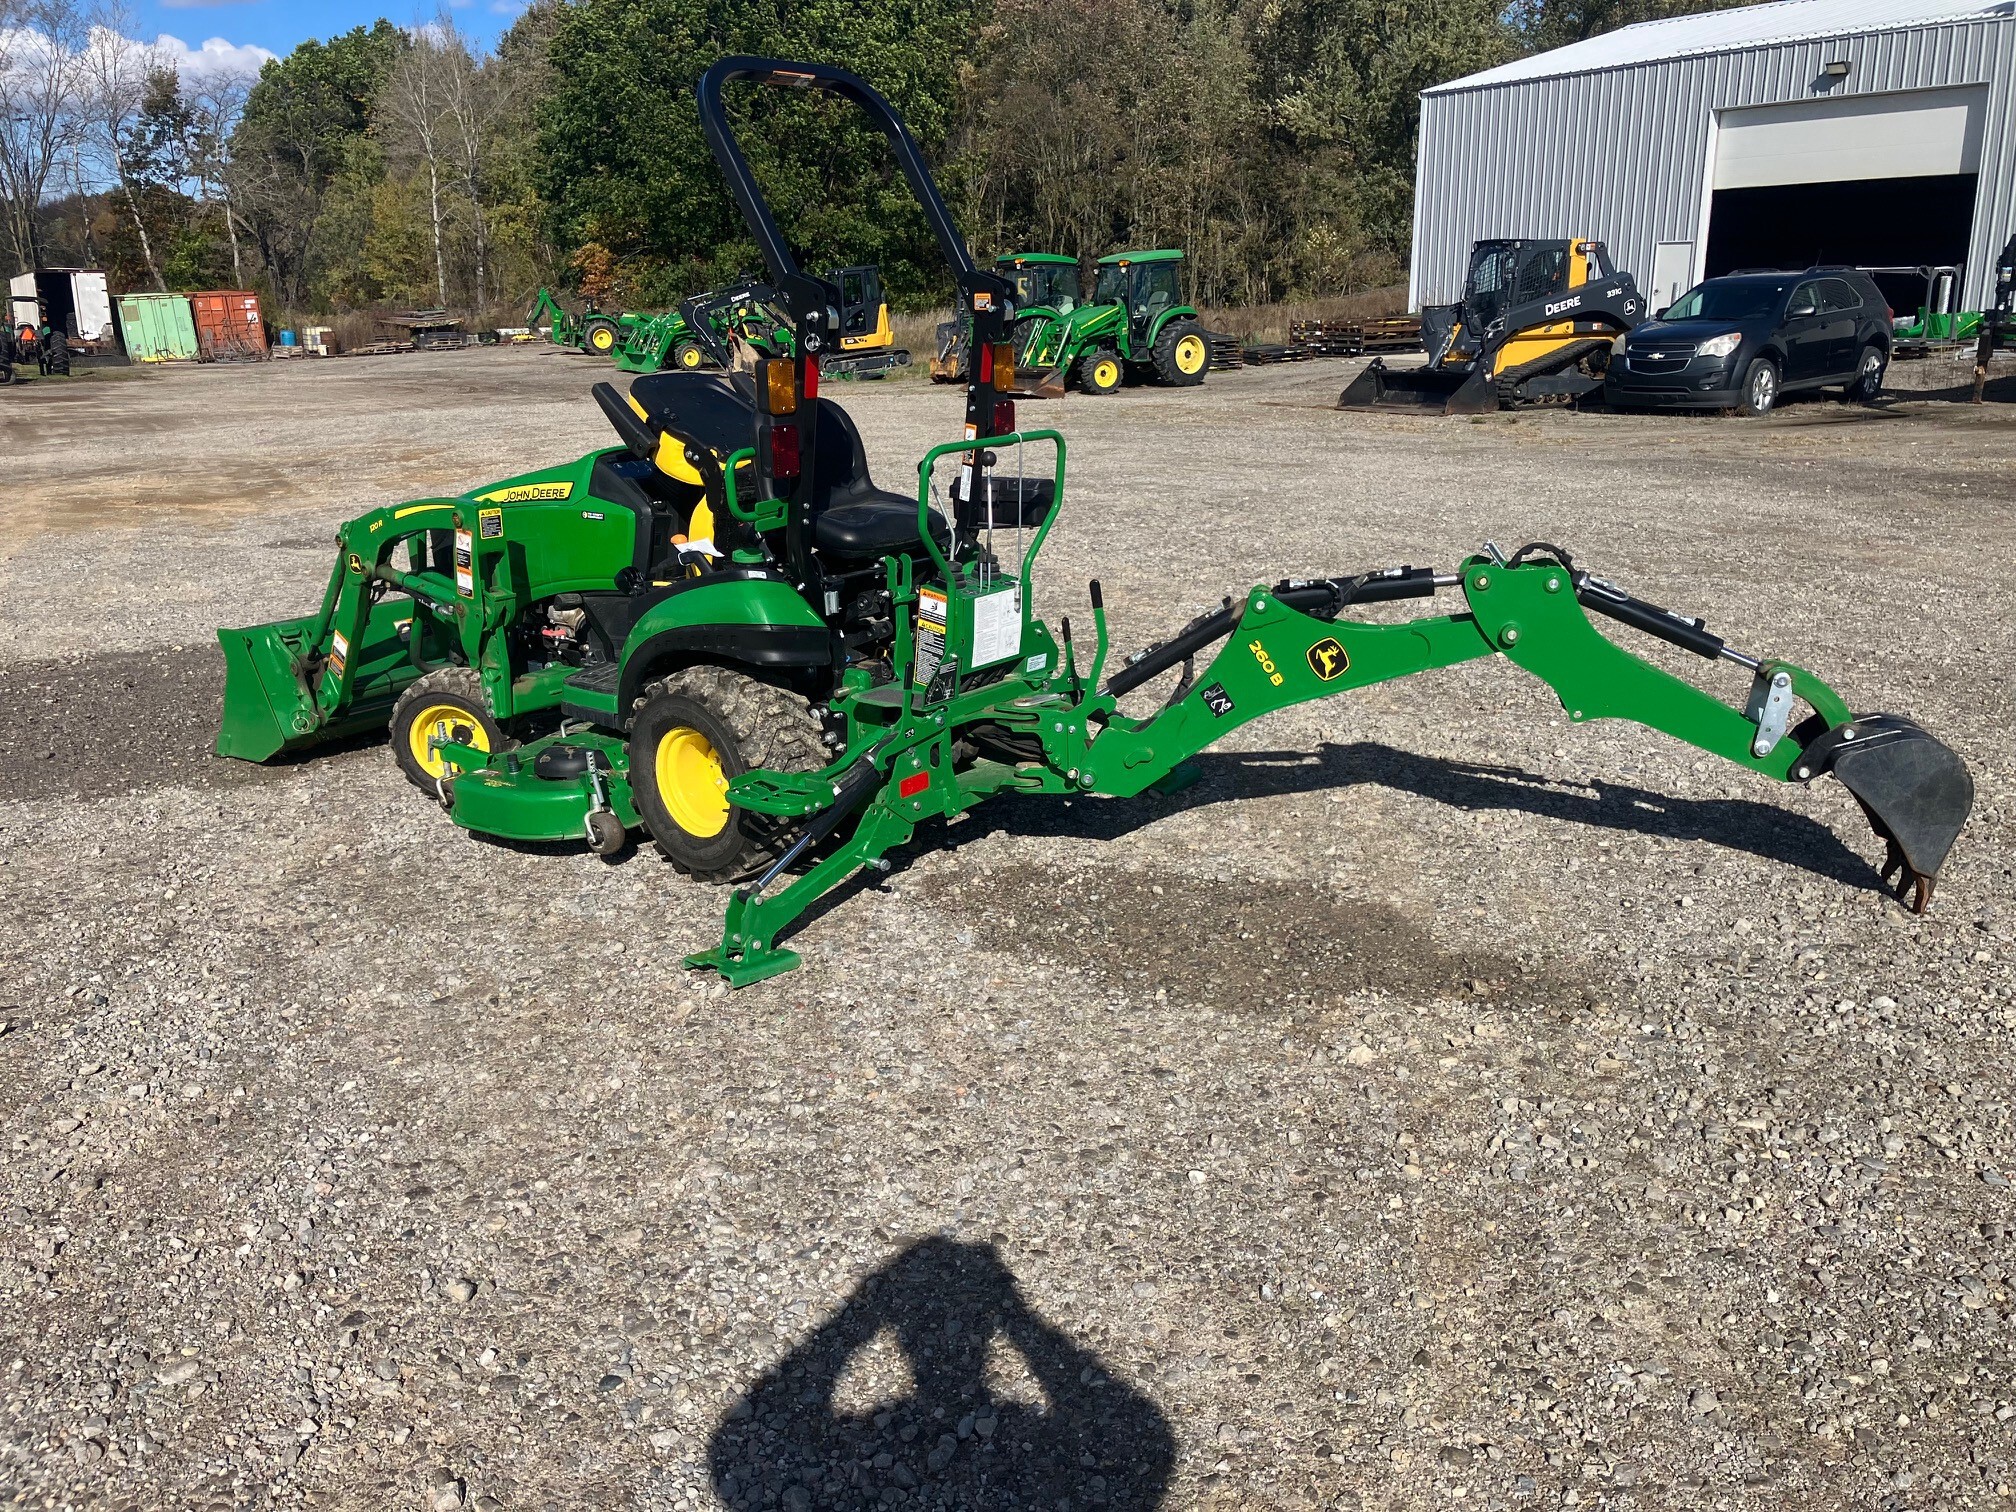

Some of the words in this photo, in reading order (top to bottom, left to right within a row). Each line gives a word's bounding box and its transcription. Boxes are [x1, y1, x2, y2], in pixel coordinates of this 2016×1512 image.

[730, 291, 751, 303] DEERE
[1606, 288, 1623, 298] 331G
[1545, 295, 1582, 316] DEERE
[504, 489, 530, 501] JOHN
[532, 488, 566, 499] DEERE
[1248, 640, 1275, 674] 260
[1269, 672, 1284, 687] B
